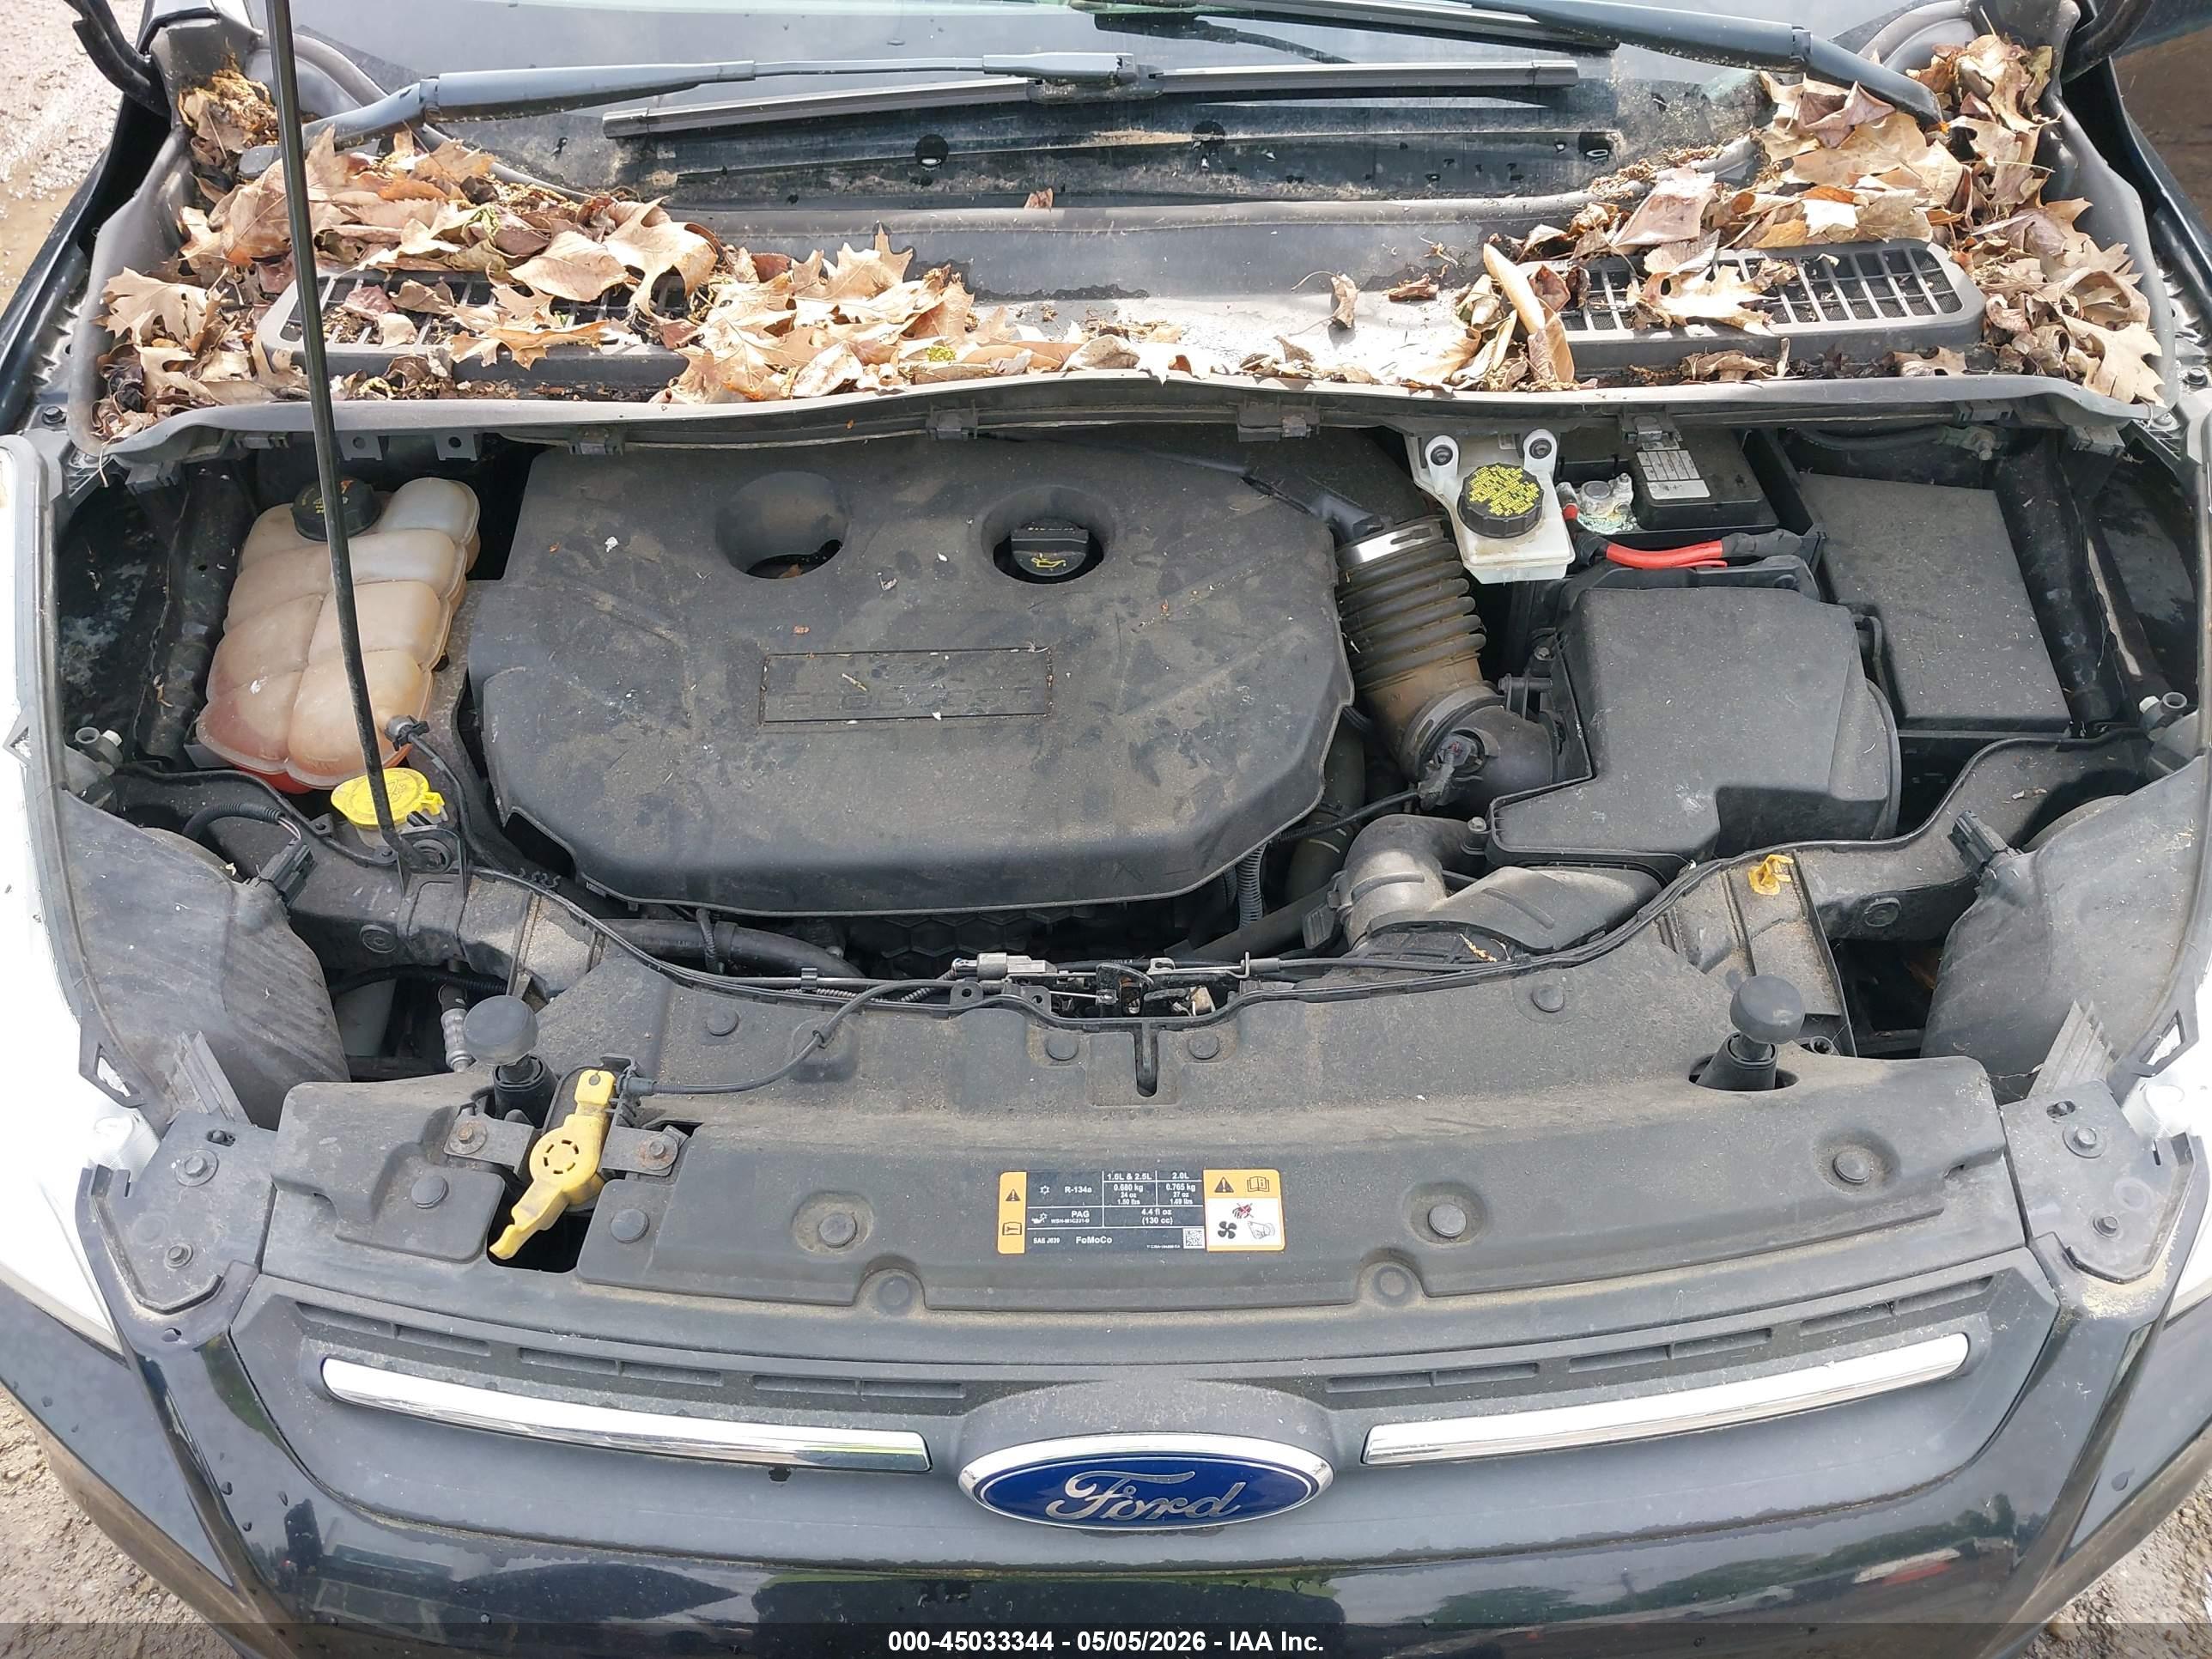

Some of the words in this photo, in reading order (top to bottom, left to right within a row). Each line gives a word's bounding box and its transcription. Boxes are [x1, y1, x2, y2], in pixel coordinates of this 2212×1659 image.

[1126, 1172, 1133, 1181] &
[1133, 1172, 1152, 1181] 2.5L
[1171, 1171, 1190, 1180] 2.0L
[1064, 1185, 1092, 1194] R-134a
[1133, 1183, 1144, 1193] kg
[1165, 1182, 1185, 1191] 0.765
[1186, 1182, 1196, 1193] kg
[1071, 1210, 1090, 1218] PAG
[1141, 1216, 1159, 1225] (130
[1160, 1216, 1174, 1225] cc)
[1075, 1236, 1113, 1244] FoMoCo
[1044, 1469, 1247, 1520] Ford
